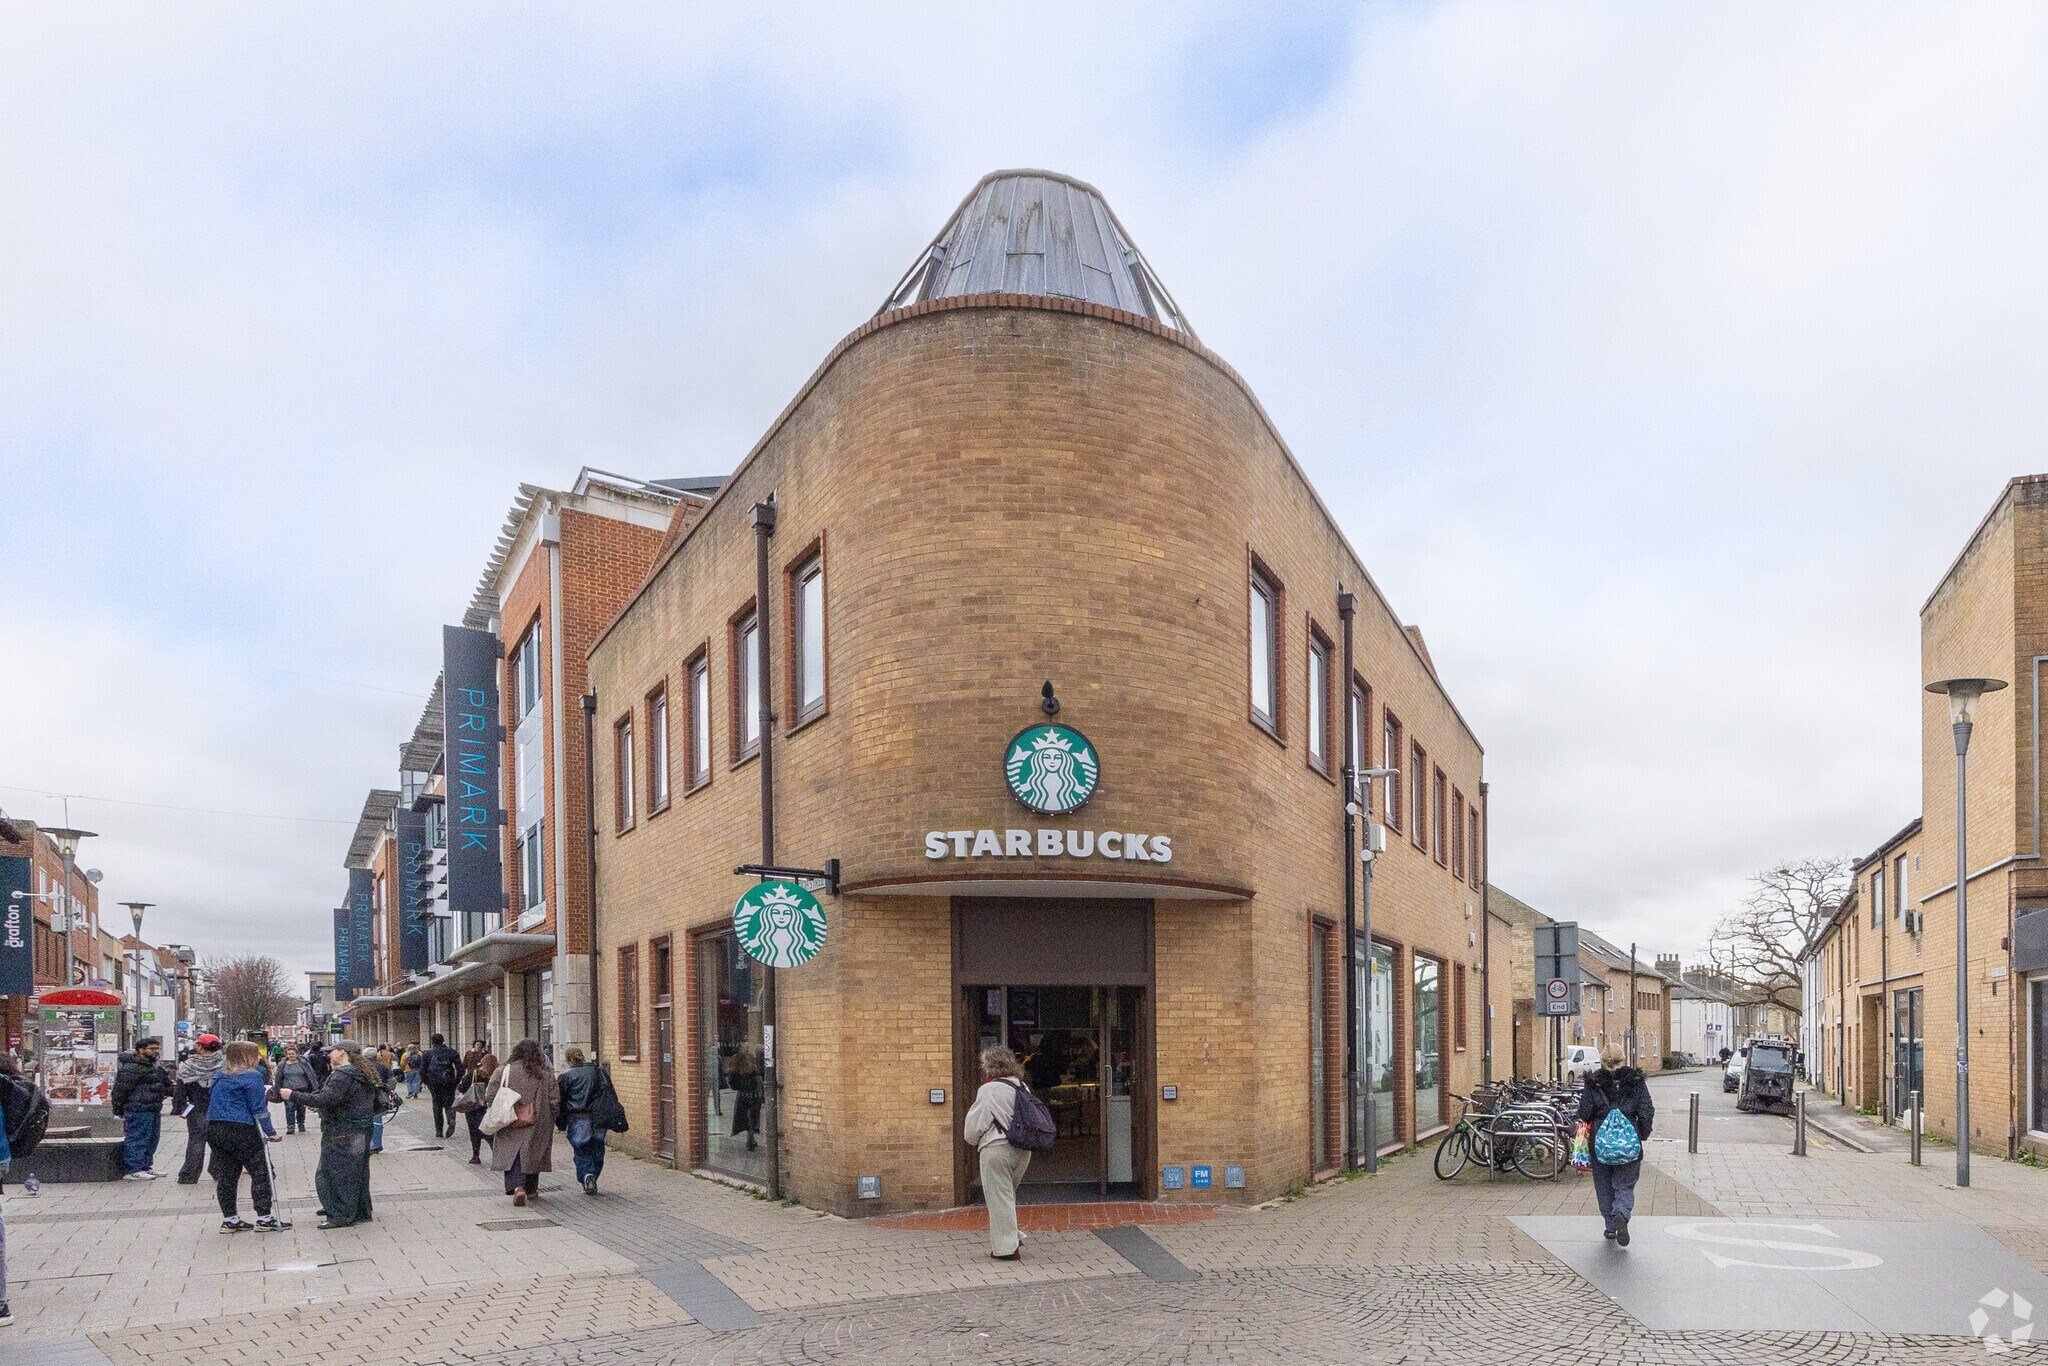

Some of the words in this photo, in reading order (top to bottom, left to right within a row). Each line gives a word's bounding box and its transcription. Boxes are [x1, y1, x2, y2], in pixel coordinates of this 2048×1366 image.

[458, 687, 488, 851] PRIMARK
[925, 829, 1173, 863] STARBUCKS
[405, 842, 424, 936] PRIMARK
[4, 904, 24, 948] grafton
[354, 892, 370, 963] PRIMARK
[338, 927, 349, 983] PRIMARK
[1195, 1170, 1208, 1178] FM
